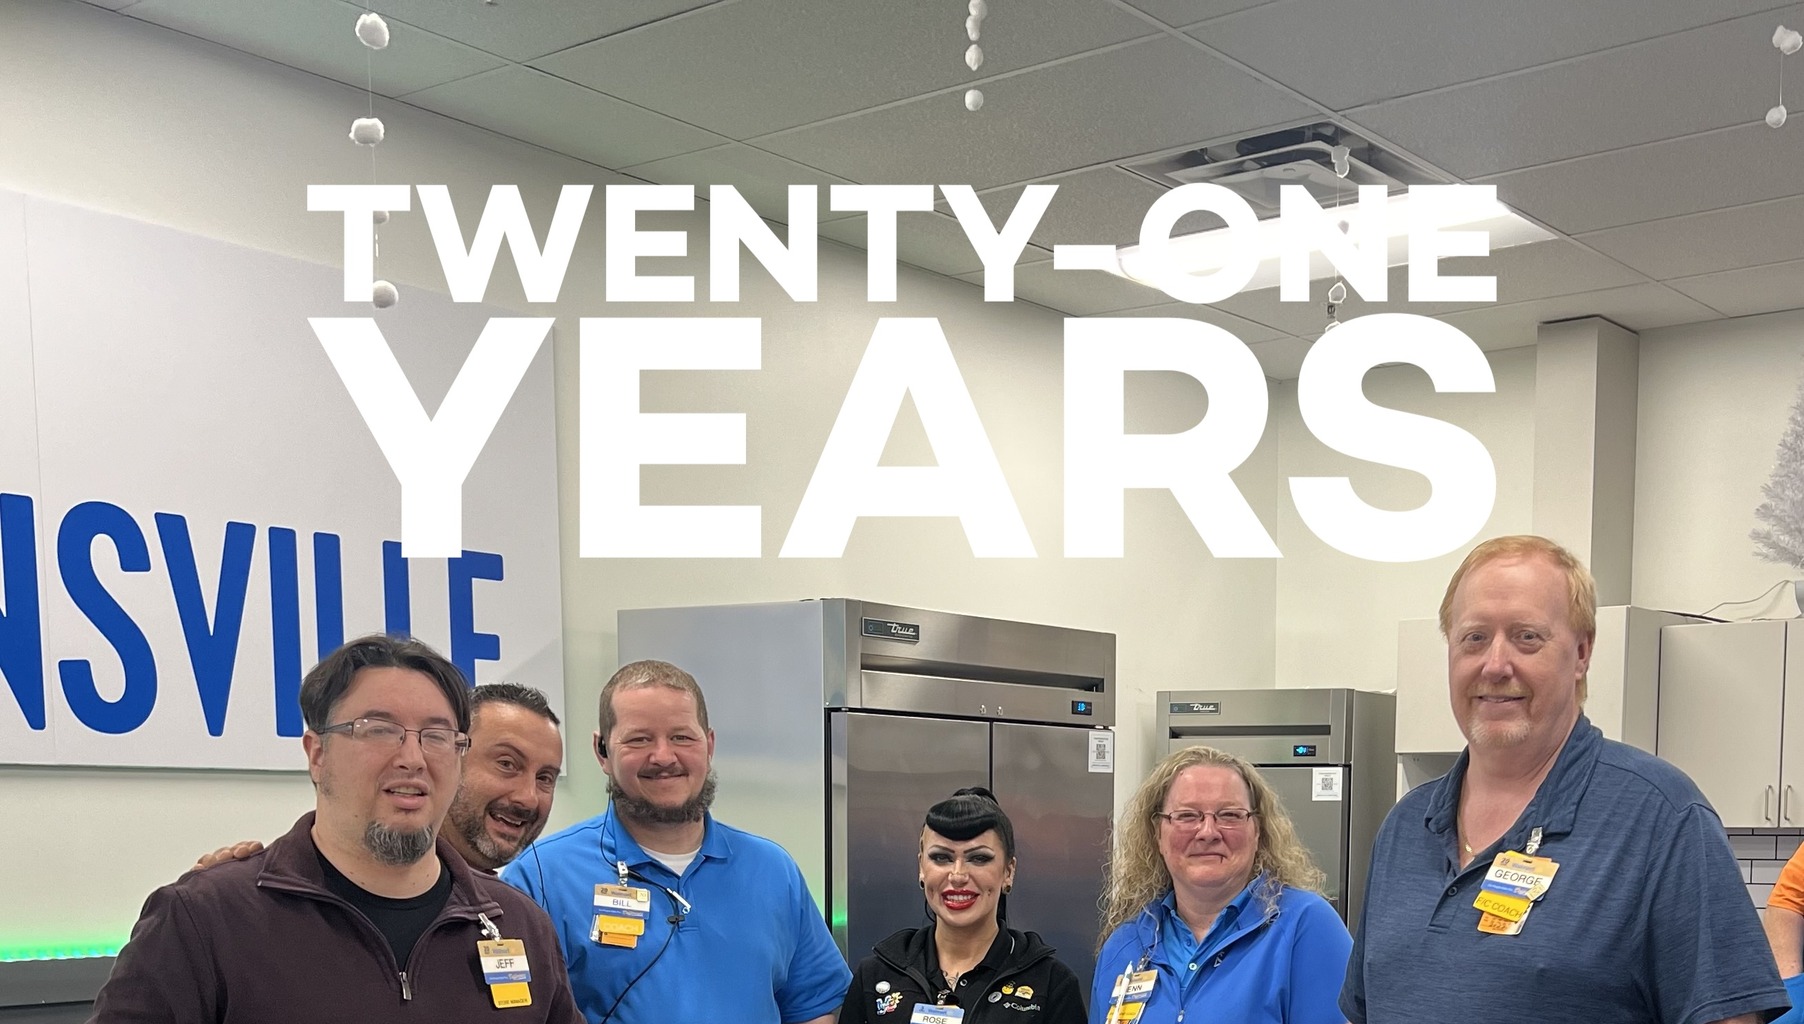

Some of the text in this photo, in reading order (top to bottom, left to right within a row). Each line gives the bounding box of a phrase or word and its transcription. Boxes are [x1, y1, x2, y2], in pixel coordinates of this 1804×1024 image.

[1494, 868, 1543, 886] GEORGE
[612, 898, 632, 908] BILL
[1491, 901, 1524, 920] COACH
[495, 958, 516, 970] JEFF
